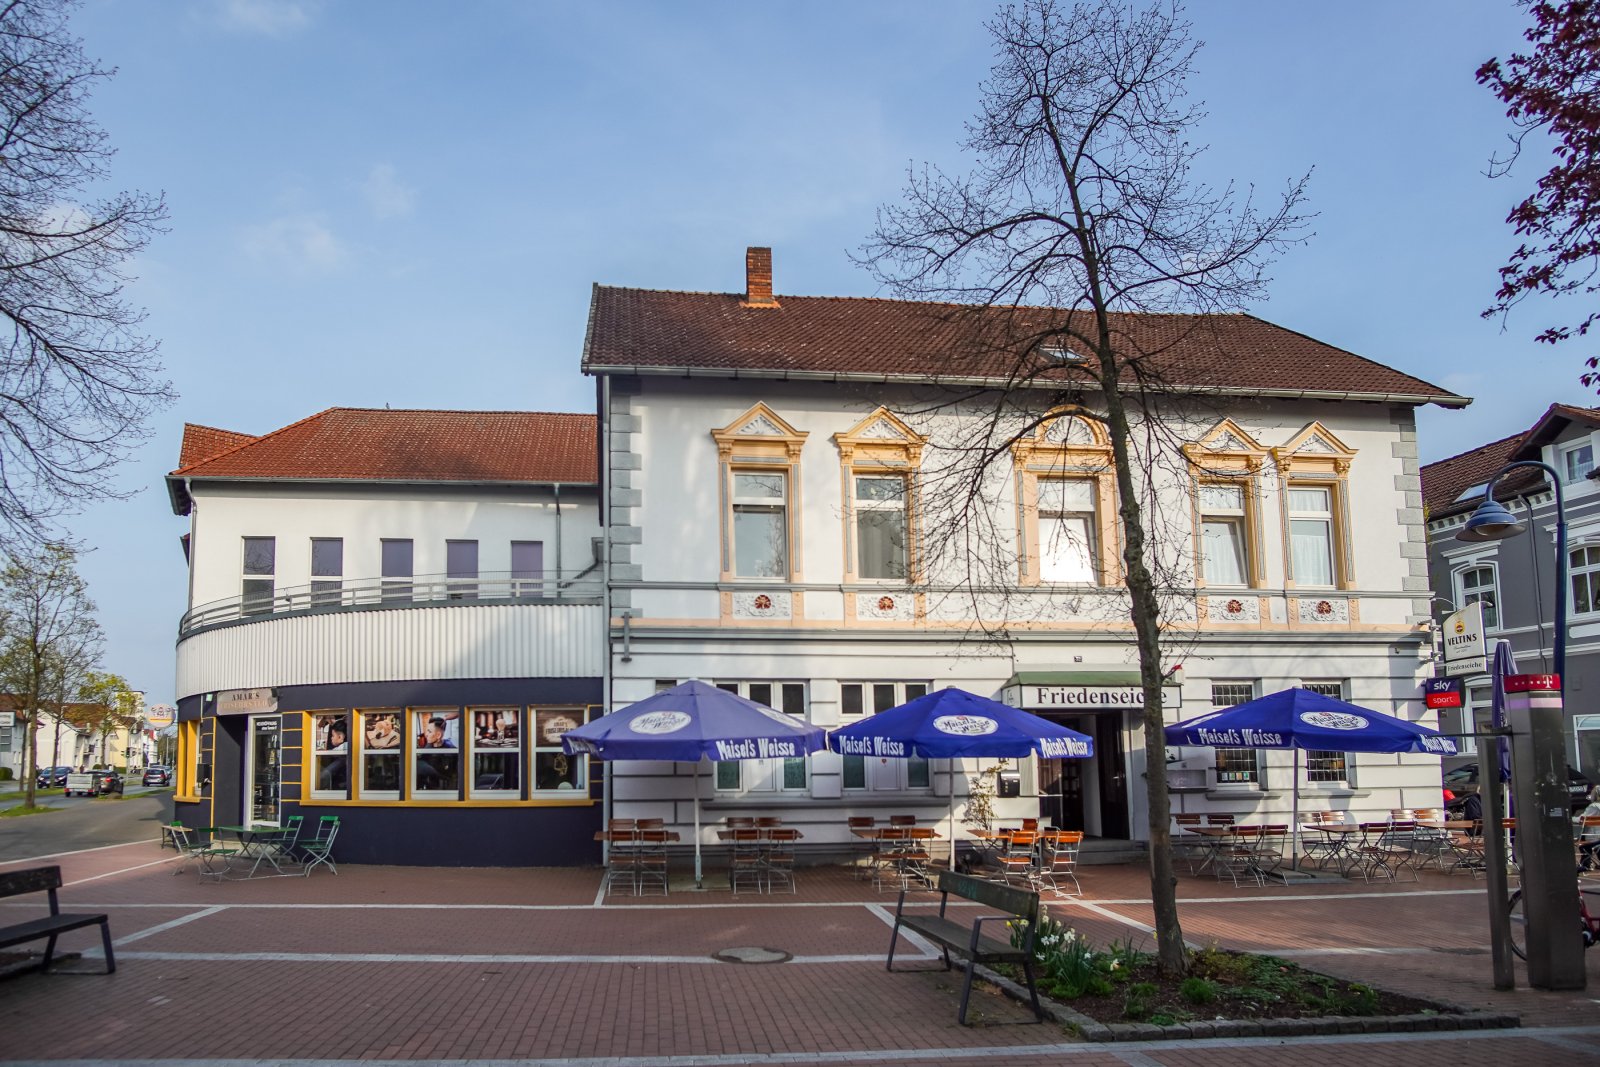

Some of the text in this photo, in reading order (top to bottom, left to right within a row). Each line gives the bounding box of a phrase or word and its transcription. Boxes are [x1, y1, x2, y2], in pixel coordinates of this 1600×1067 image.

[1447, 633, 1477, 646] VELTINS
[1447, 661, 1482, 672] Friedenseiche
[1433, 680, 1451, 691] sky
[1543, 675, 1552, 688] T
[1036, 687, 1167, 704] Friedenseice
[1433, 696, 1454, 704] sport
[1198, 728, 1282, 745] Maisel's Weisse
[716, 738, 795, 760] Maisel's Weisse
[839, 735, 904, 756] Maisel's Weisse
[1039, 737, 1088, 758] Maisel's Weisse
